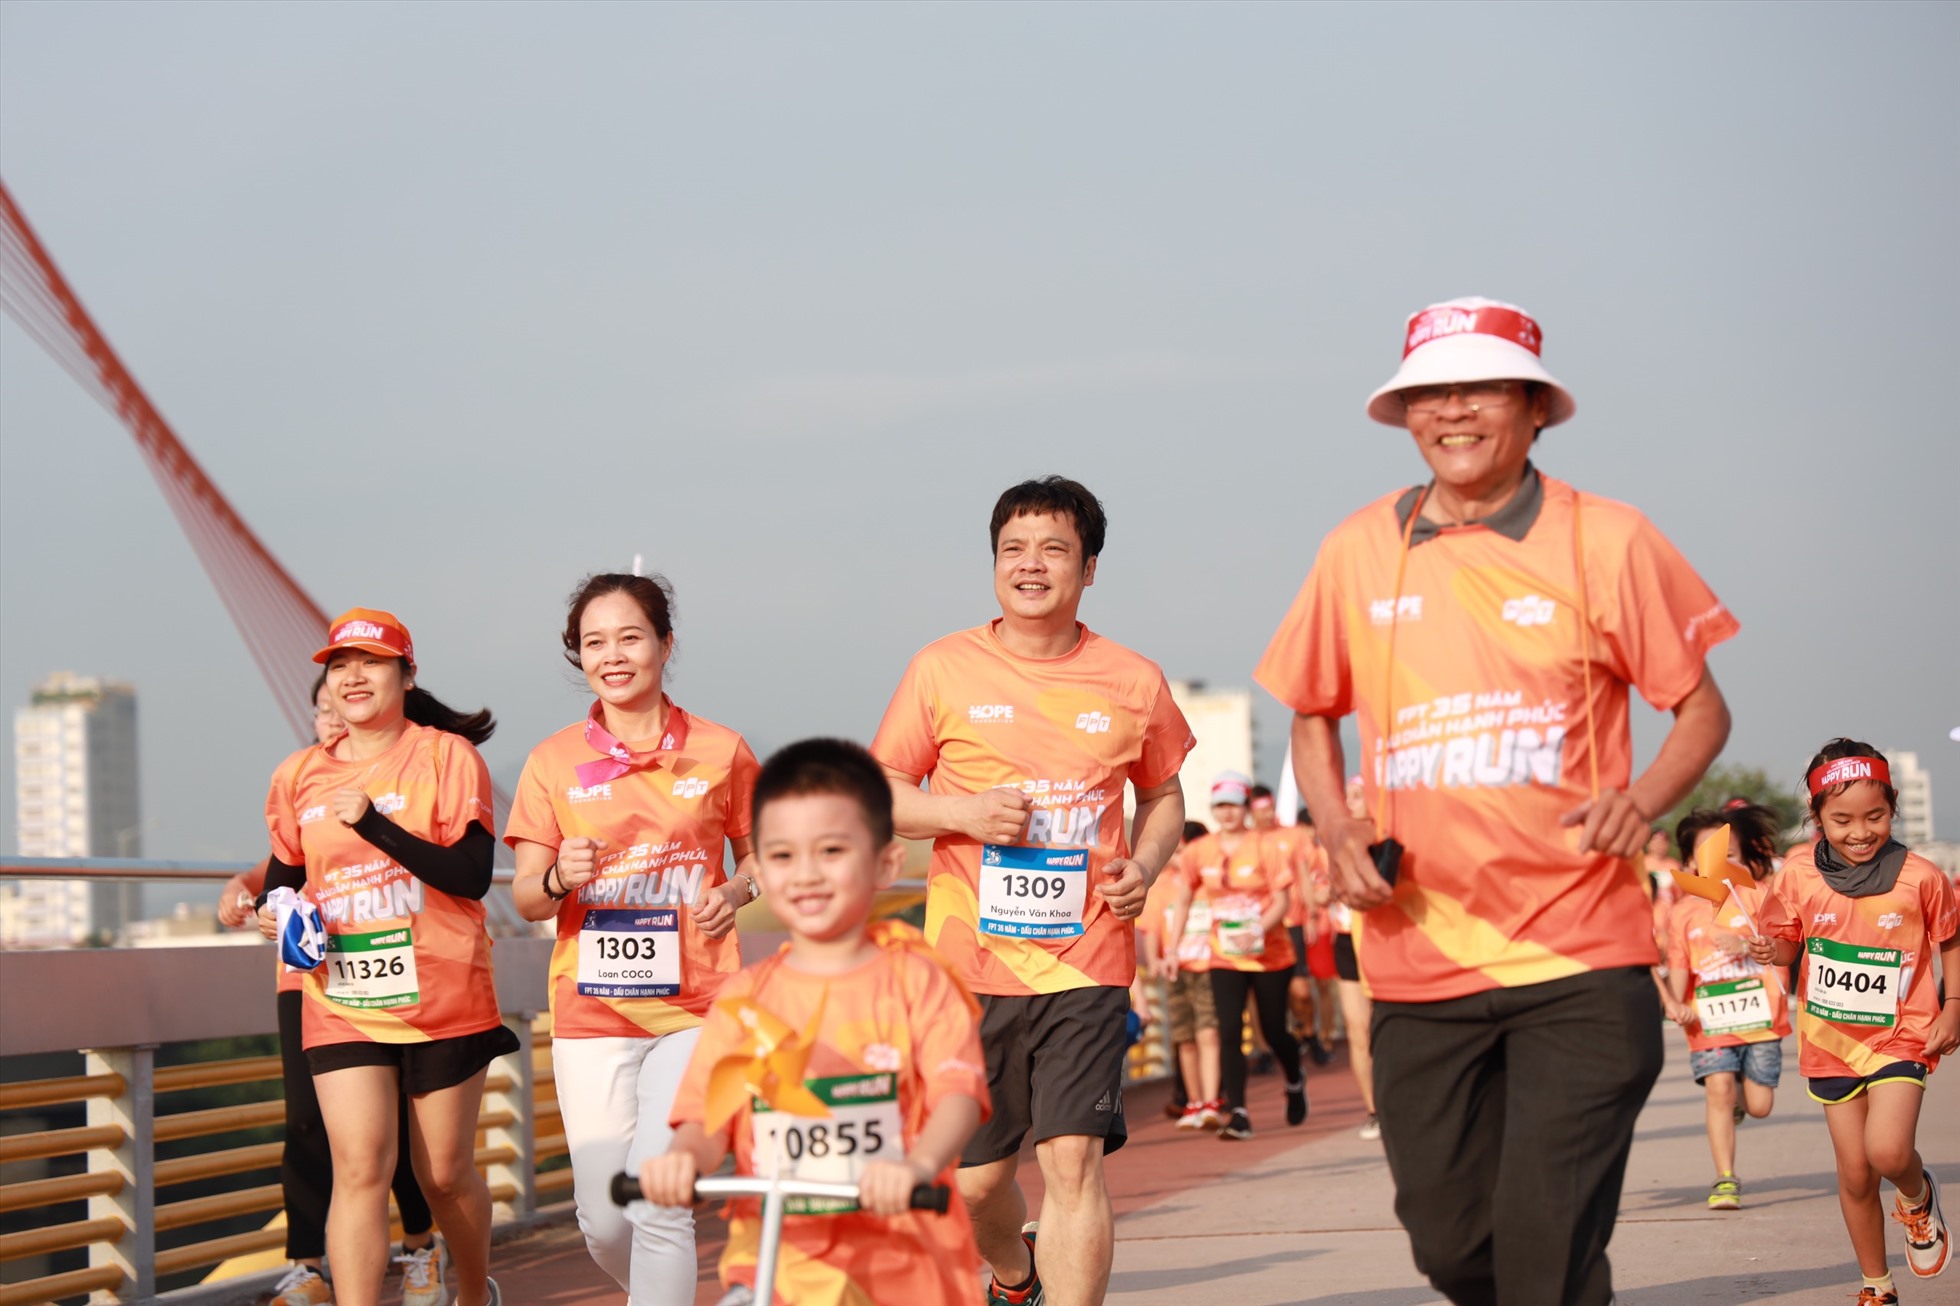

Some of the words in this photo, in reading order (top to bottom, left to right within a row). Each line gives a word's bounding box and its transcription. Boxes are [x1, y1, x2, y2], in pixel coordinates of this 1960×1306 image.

[1433, 312, 1477, 337] RUN
[351, 626, 383, 640] RUN
[969, 704, 1014, 719] HOPE
[1397, 703, 1429, 725] FPT
[1431, 693, 1472, 719] 35
[1507, 699, 1567, 727] PHÚC
[1075, 711, 1112, 734] FPT
[1445, 726, 1565, 789] RUN
[1821, 769, 1841, 786] HAPPY
[1841, 762, 1872, 780] RUN
[672, 777, 709, 799] FPT
[1022, 779, 1050, 793] 35
[1053, 779, 1086, 791] NĂM
[1026, 804, 1106, 847] RUN
[600, 850, 626, 866] FPT
[627, 843, 651, 860] 35
[651, 841, 682, 855] NĂM
[630, 856, 668, 872] HẠNH
[1063, 854, 1084, 866] RUN
[341, 863, 363, 880] 35
[363, 858, 391, 873] NĂM
[352, 873, 382, 890] HẠNH
[577, 876, 628, 906] HAPPY
[624, 863, 706, 906] RUN
[1002, 874, 1066, 900] 1309
[353, 875, 425, 924] RUN
[652, 914, 674, 927] RUN
[1049, 909, 1072, 918] Khoa
[385, 930, 407, 944] RUN
[987, 922, 997, 931] FPT
[596, 937, 656, 960] 1303
[1874, 951, 1897, 963] RUN
[334, 955, 405, 980] 11326
[598, 969, 619, 979] Loan
[621, 970, 653, 979] COCO
[584, 986, 593, 995] FPT
[1818, 964, 1887, 995] 10404
[1707, 996, 1760, 1017] 11174
[770, 1120, 883, 1160] 0855
